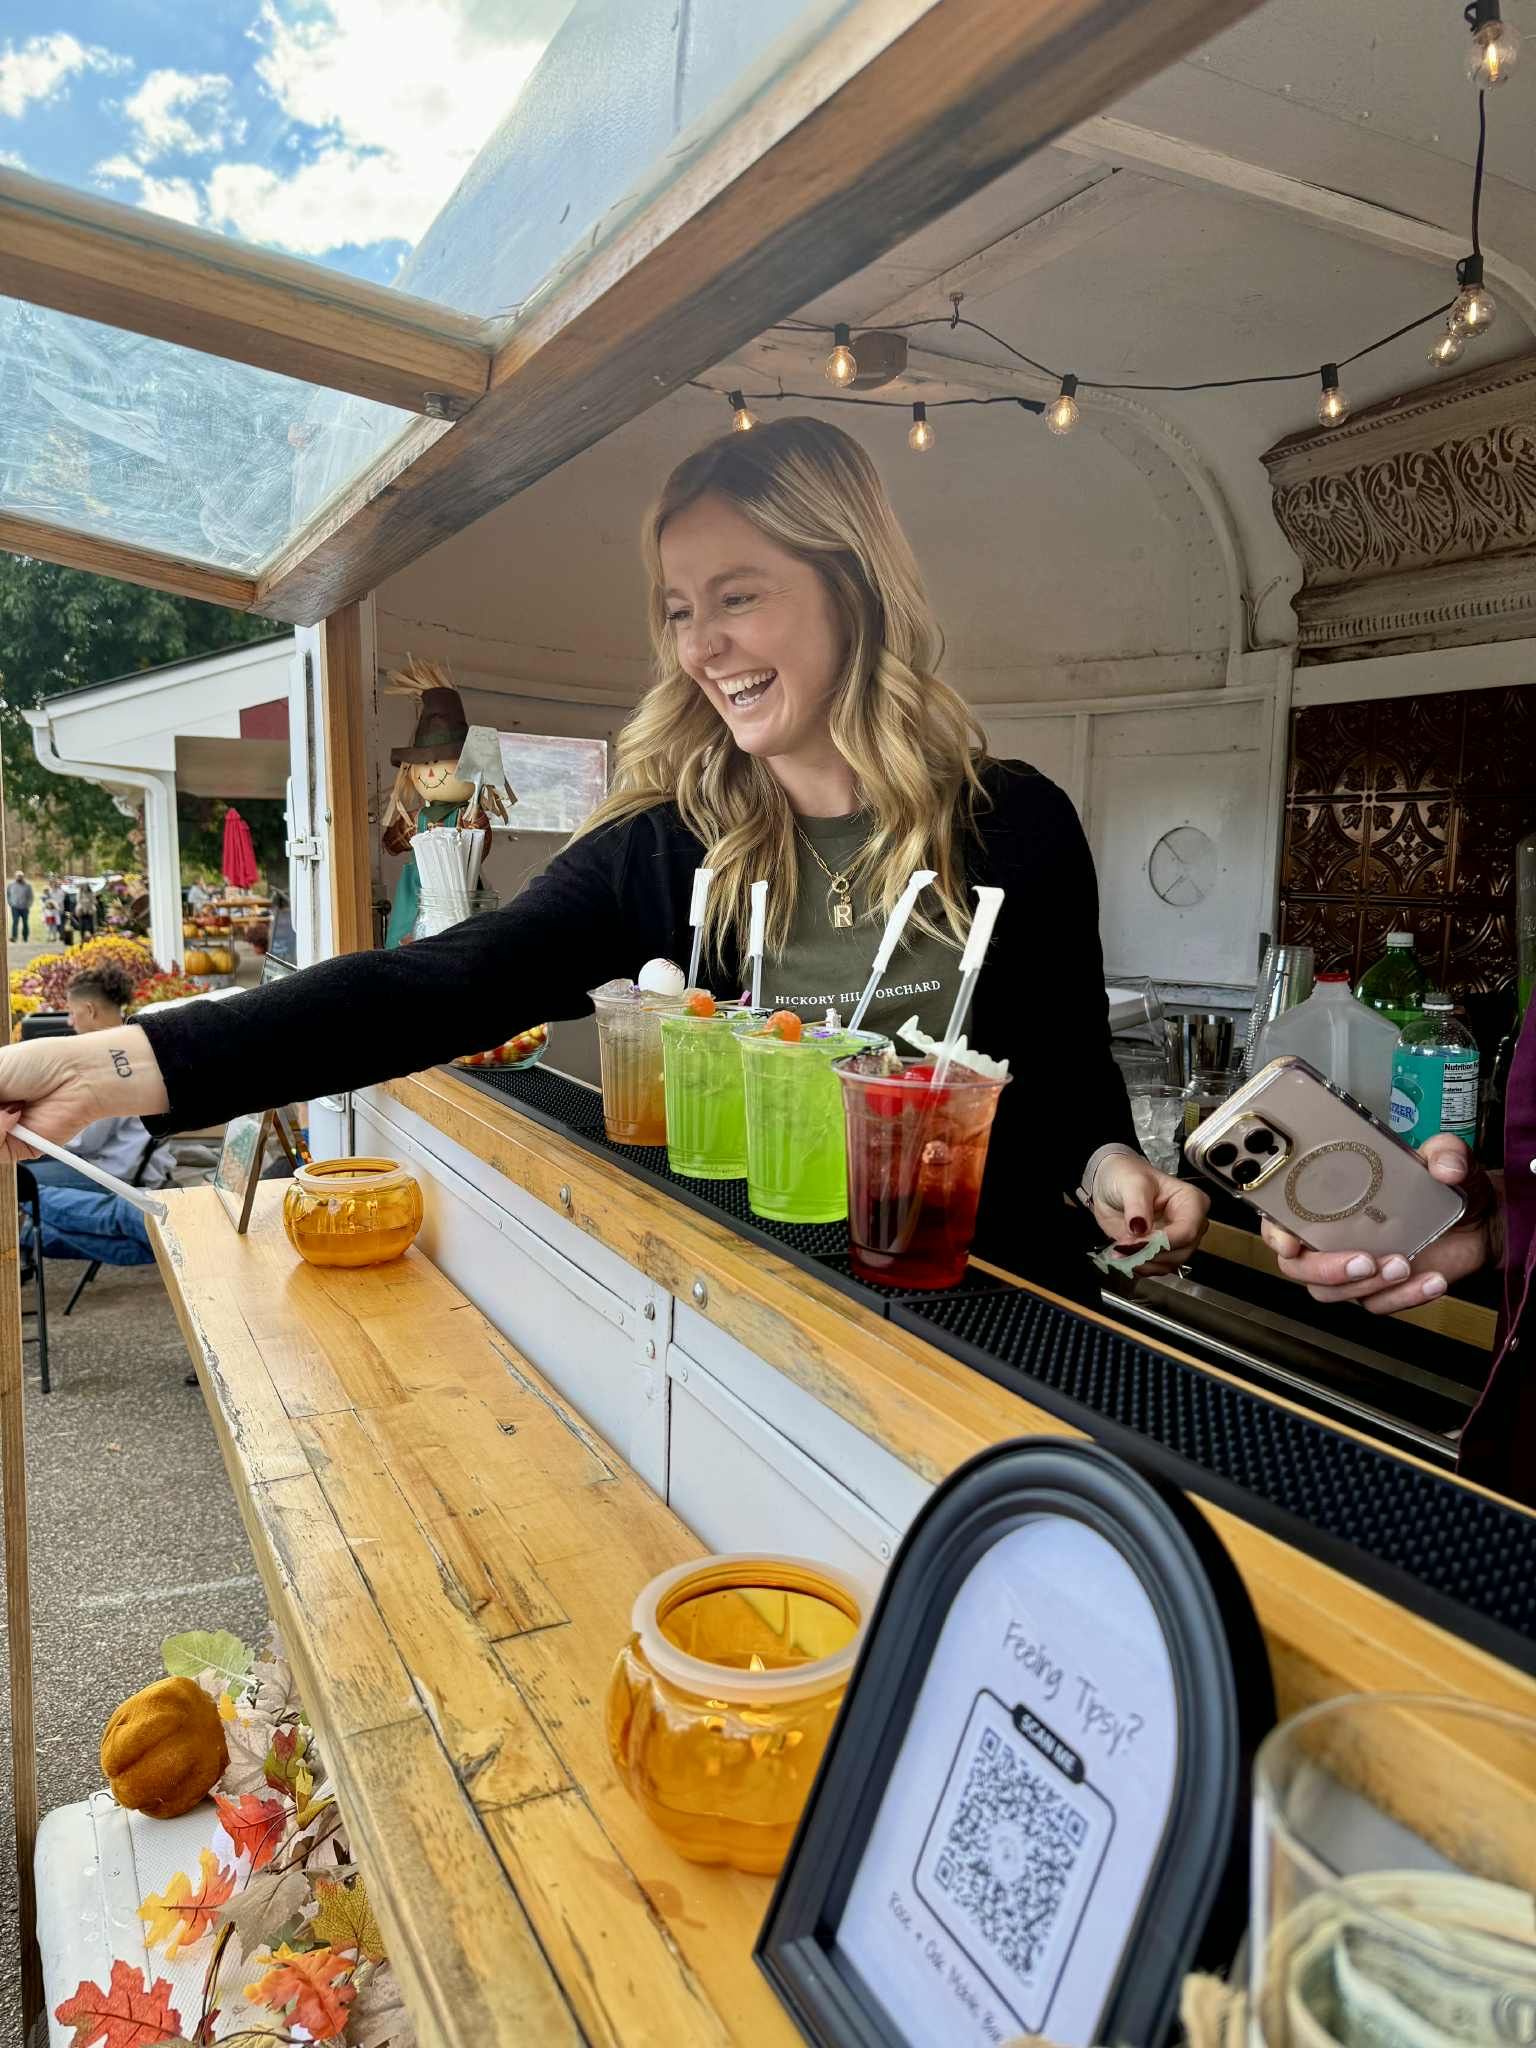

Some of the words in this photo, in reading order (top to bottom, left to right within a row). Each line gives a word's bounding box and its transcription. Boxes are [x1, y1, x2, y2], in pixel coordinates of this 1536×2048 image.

[837, 905, 853, 927] R
[775, 994, 836, 1005] HICKORY
[840, 991, 864, 1003] HIL
[875, 980, 941, 999] ORCHARD
[1444, 1063, 1473, 1071] Nutrition
[1020, 1713, 1057, 1755] SCAN
